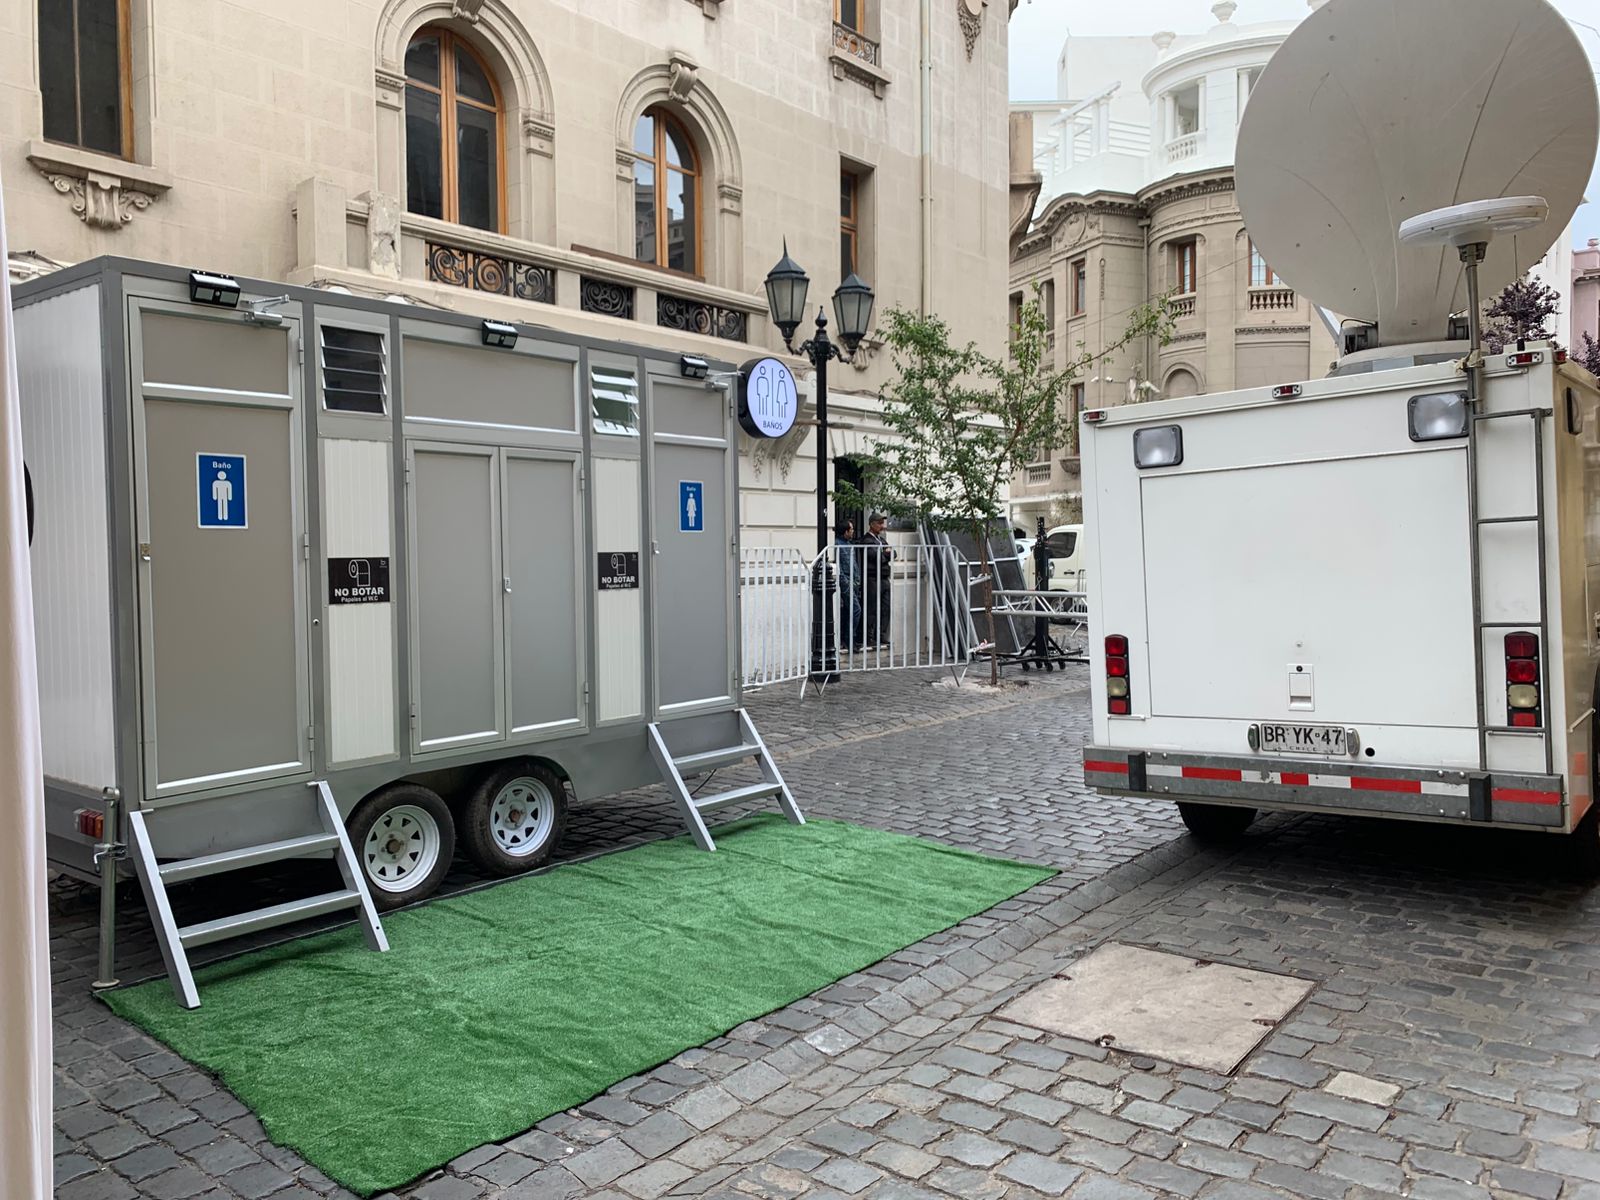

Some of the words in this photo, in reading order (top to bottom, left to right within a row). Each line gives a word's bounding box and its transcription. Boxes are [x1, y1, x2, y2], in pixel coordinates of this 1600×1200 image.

[212, 460, 232, 470] Baño
[601, 576, 612, 584] NO
[613, 575, 636, 583] BOTAR
[334, 588, 350, 597] NO
[351, 587, 385, 596] BOTAR
